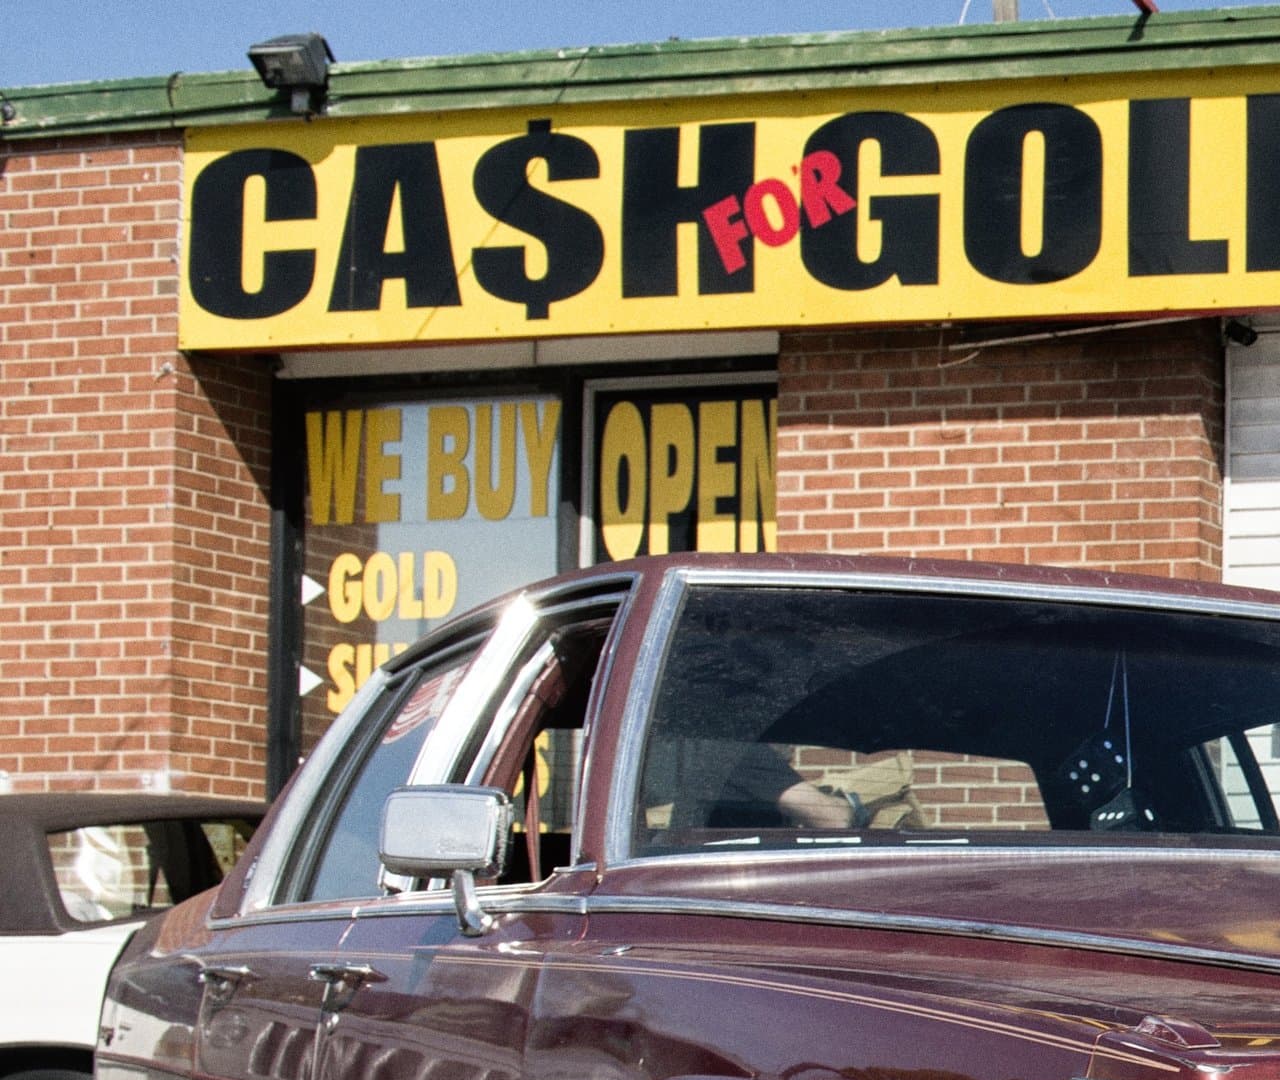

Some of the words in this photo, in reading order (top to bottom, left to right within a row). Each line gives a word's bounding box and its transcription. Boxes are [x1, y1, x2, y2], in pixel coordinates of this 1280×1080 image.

[190, 119, 758, 321] CA$H
[701, 149, 856, 275] FOR
[305, 408, 402, 526] WE
[426, 401, 562, 521] BUY
[601, 400, 778, 562] OPEN
[327, 550, 459, 624] GOLD
